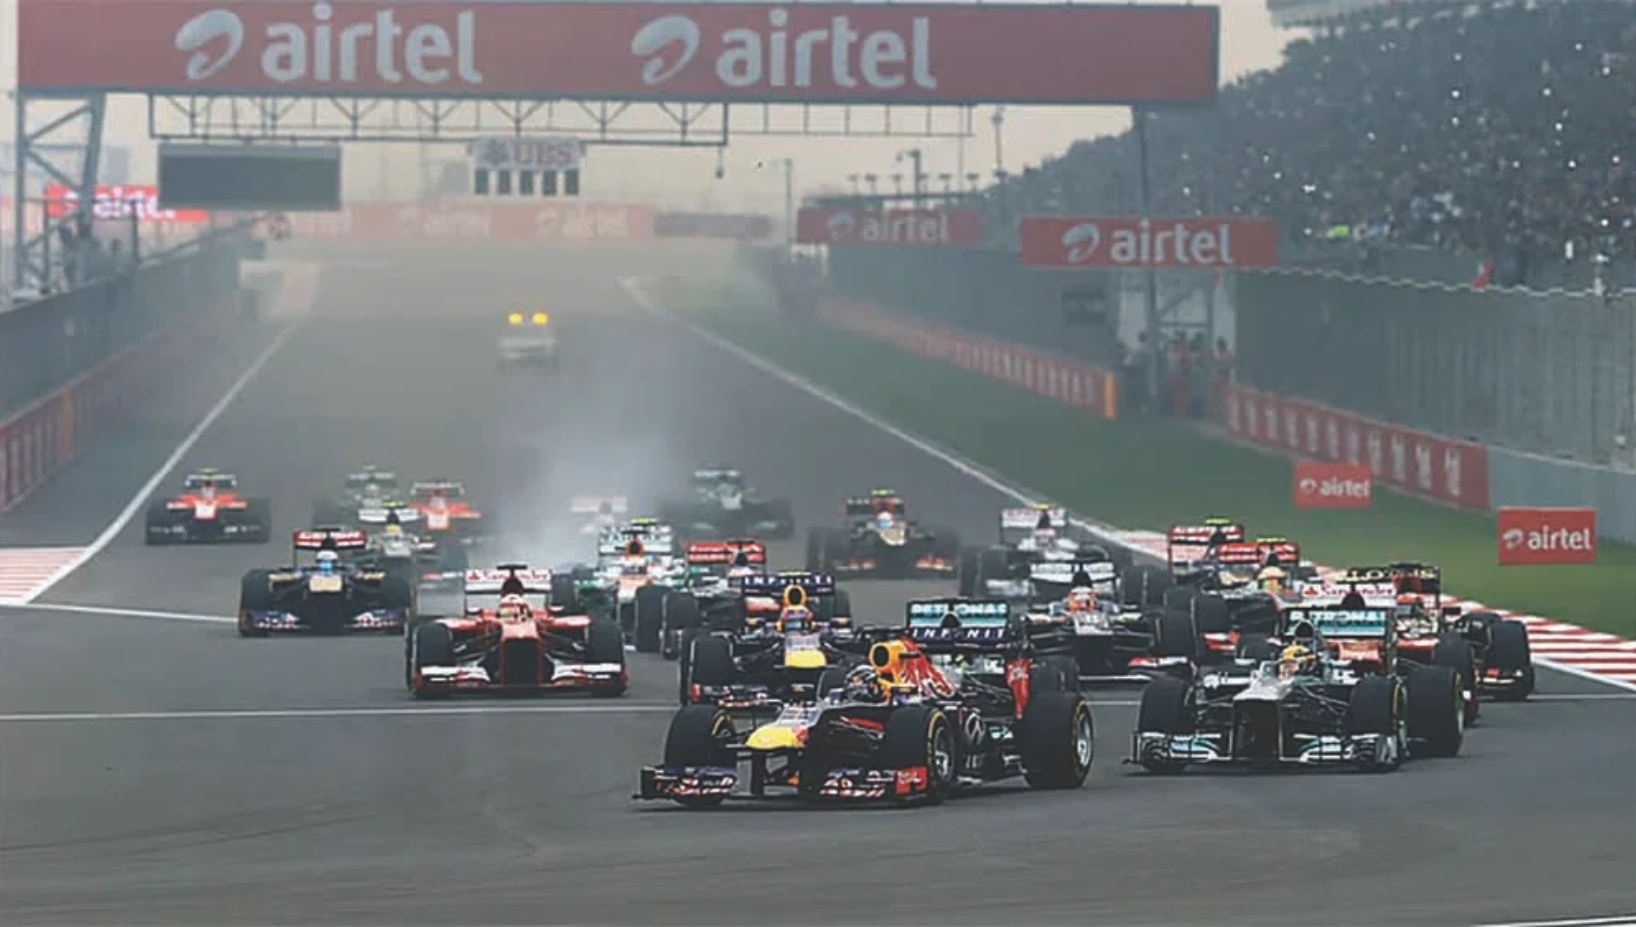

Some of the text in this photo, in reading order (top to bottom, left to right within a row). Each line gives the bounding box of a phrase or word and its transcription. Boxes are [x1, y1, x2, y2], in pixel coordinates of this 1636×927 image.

[261, 3, 483, 84] airtel
[716, 9, 938, 89] airtel
[513, 142, 577, 168] UBS
[862, 207, 950, 244] airtel
[1110, 218, 1234, 264] airtel
[1319, 475, 1370, 499] airtel
[1527, 523, 1593, 551] airtel
[1324, 583, 1394, 596] Sannder
[910, 603, 1007, 614] PETONAS
